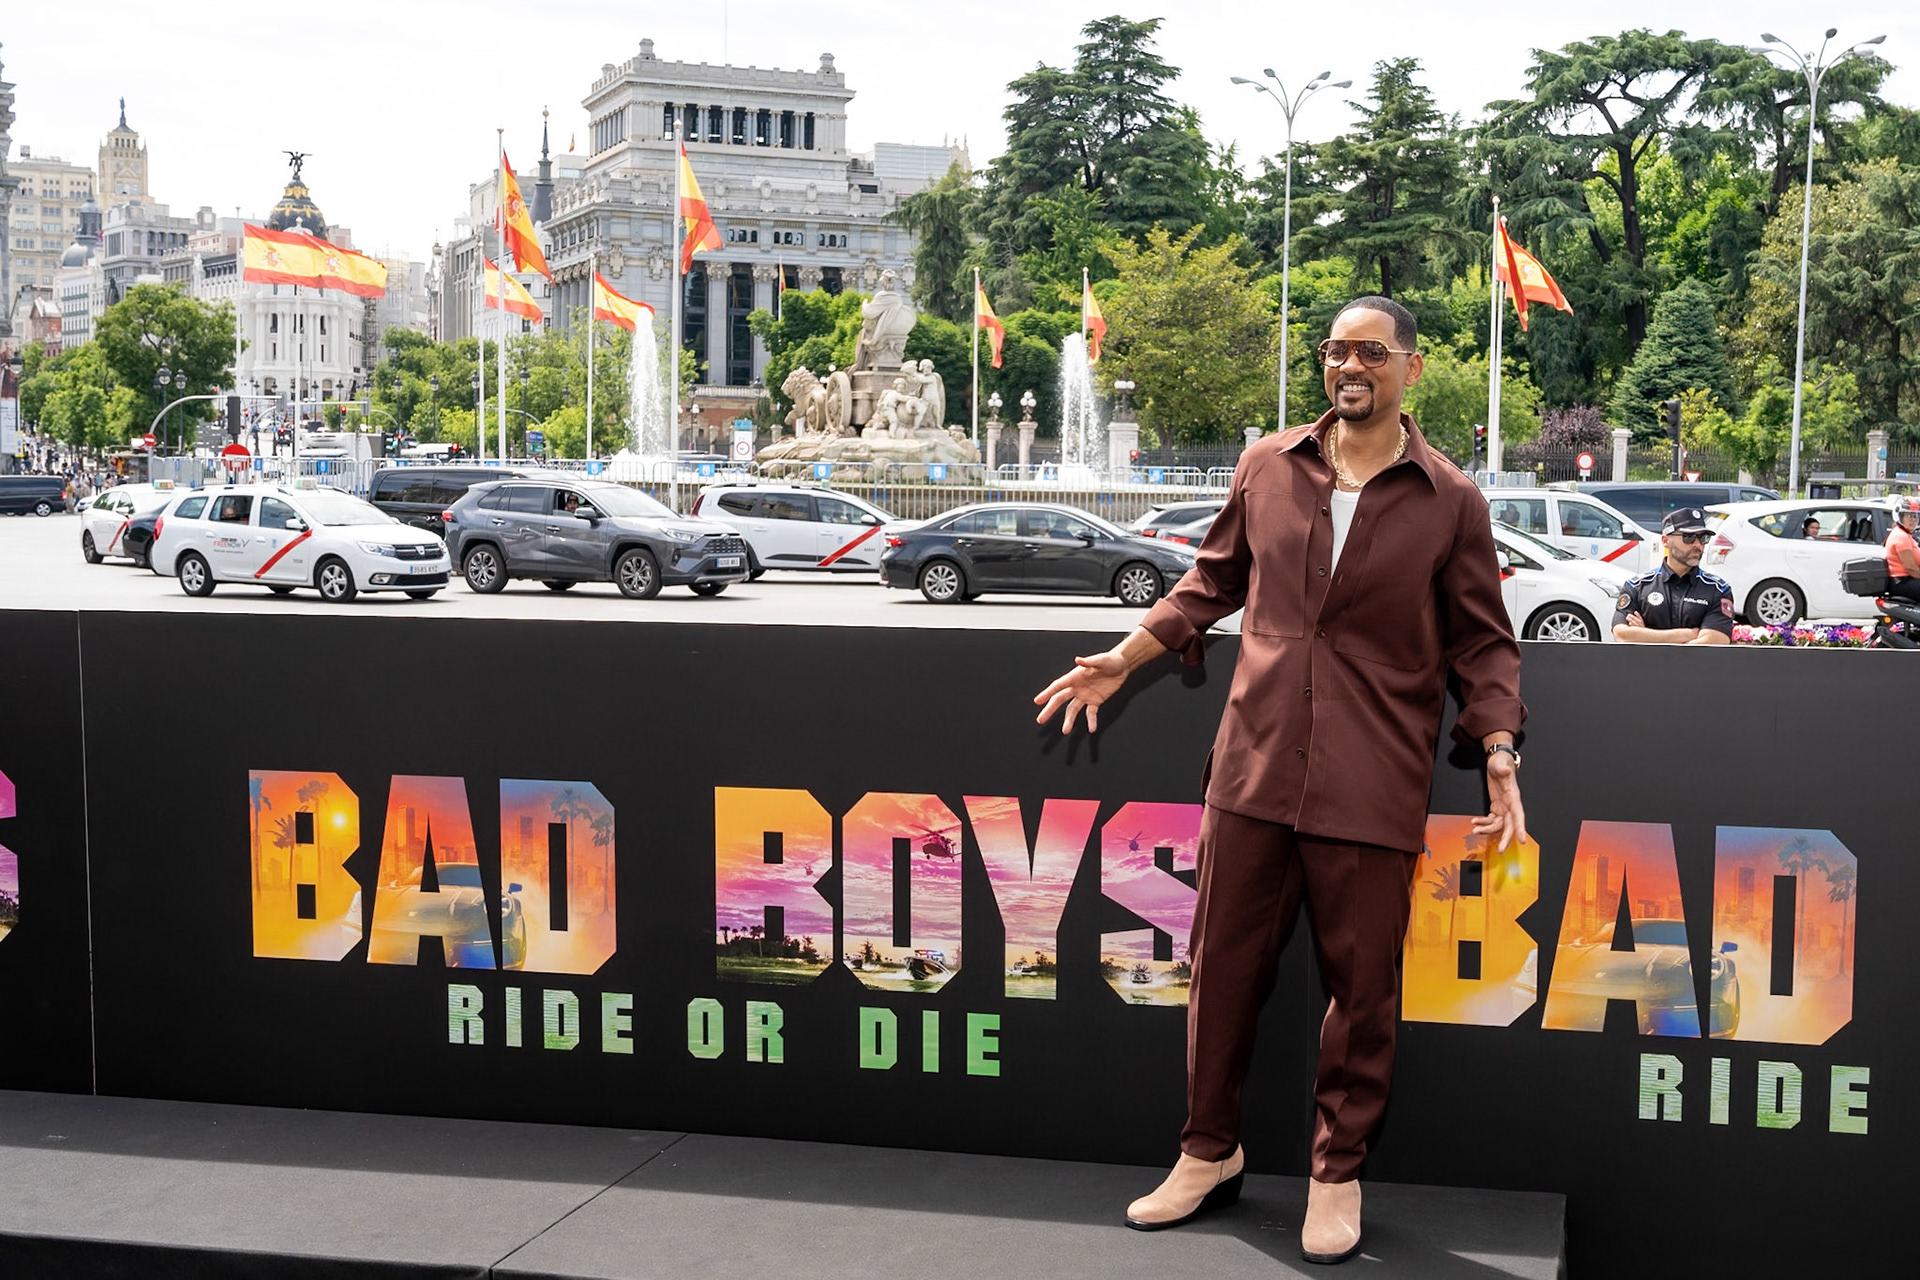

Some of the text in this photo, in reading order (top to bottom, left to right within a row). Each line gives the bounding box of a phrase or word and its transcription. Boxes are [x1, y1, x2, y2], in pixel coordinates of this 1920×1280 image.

[249, 769, 617, 976] BAD
[714, 786, 1204, 1008] BOYS
[1401, 814, 1858, 1047] BAD
[448, 983, 1001, 1078] RIDE OR DIE
[1638, 1053, 1871, 1135] RIDE
